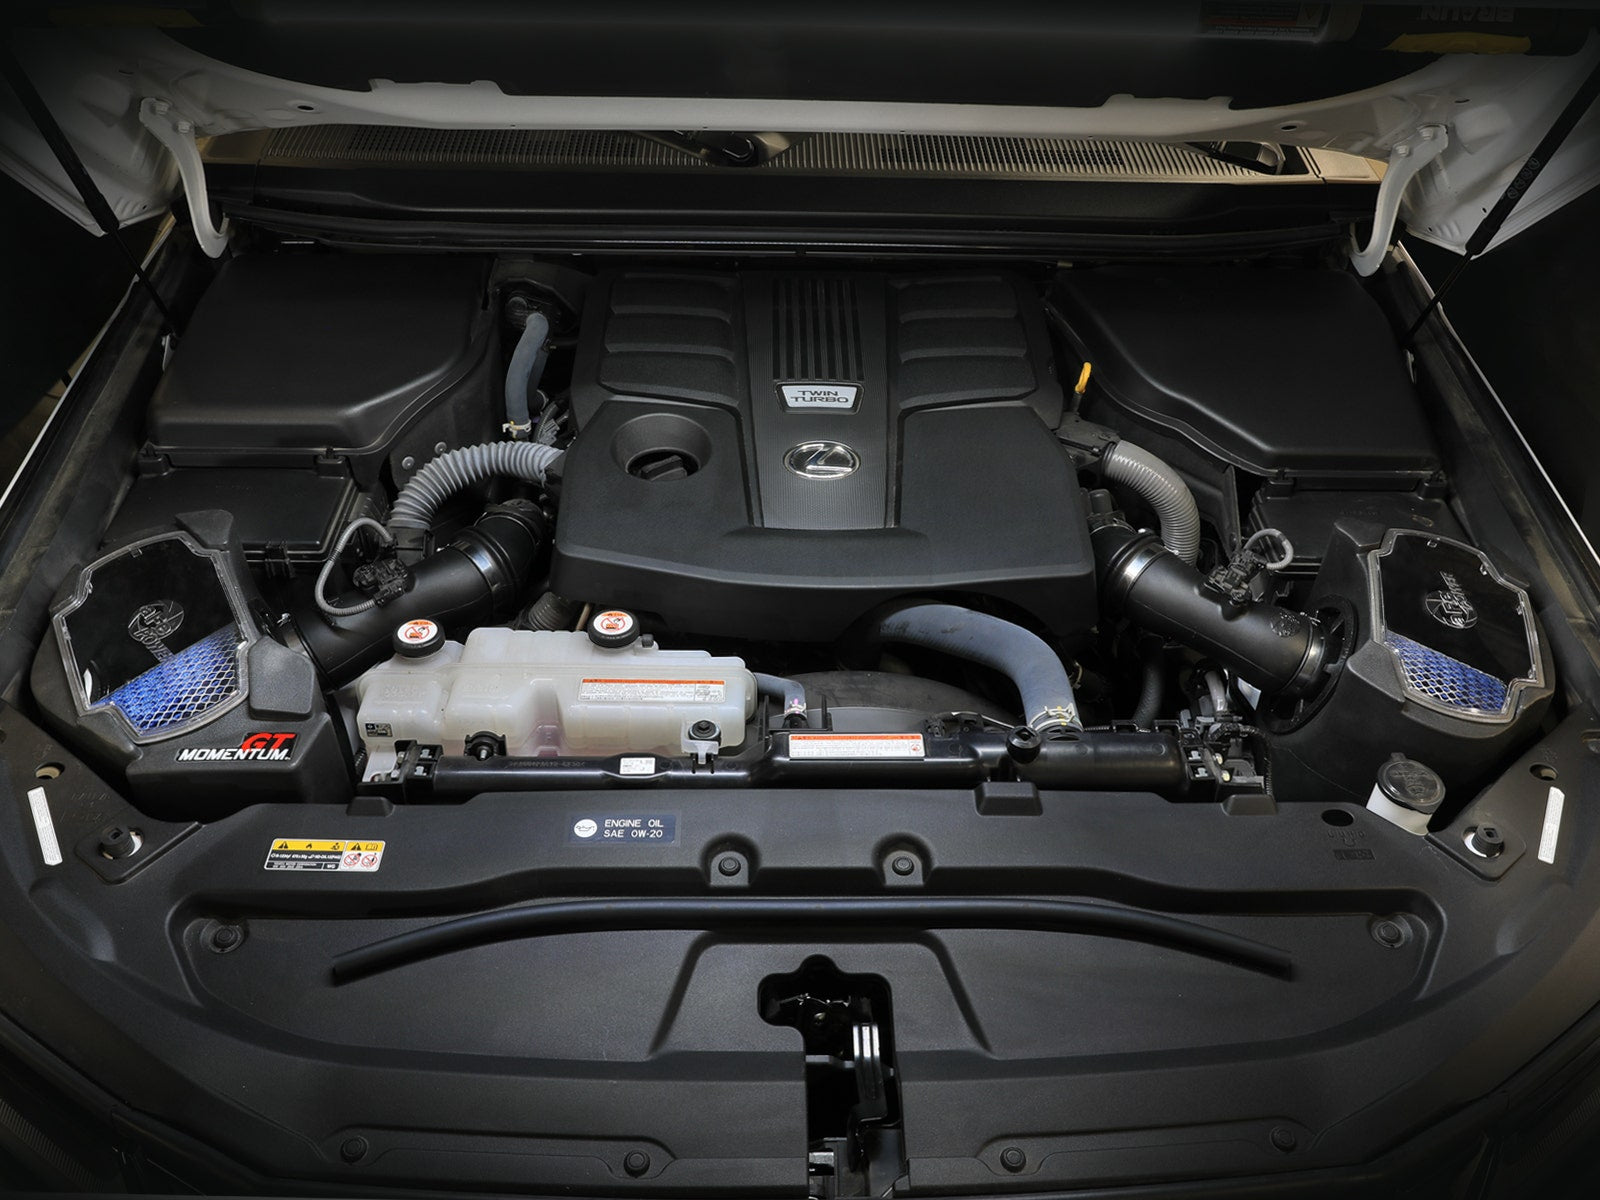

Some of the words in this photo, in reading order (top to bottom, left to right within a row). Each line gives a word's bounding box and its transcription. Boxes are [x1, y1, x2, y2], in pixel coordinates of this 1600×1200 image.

[242, 733, 296, 751] GT
[178, 749, 288, 761] MOMENTUM
[604, 819, 642, 828] ENGINE
[647, 819, 664, 828] OIL
[603, 829, 625, 838] SAE
[630, 829, 663, 838] 0W-20
